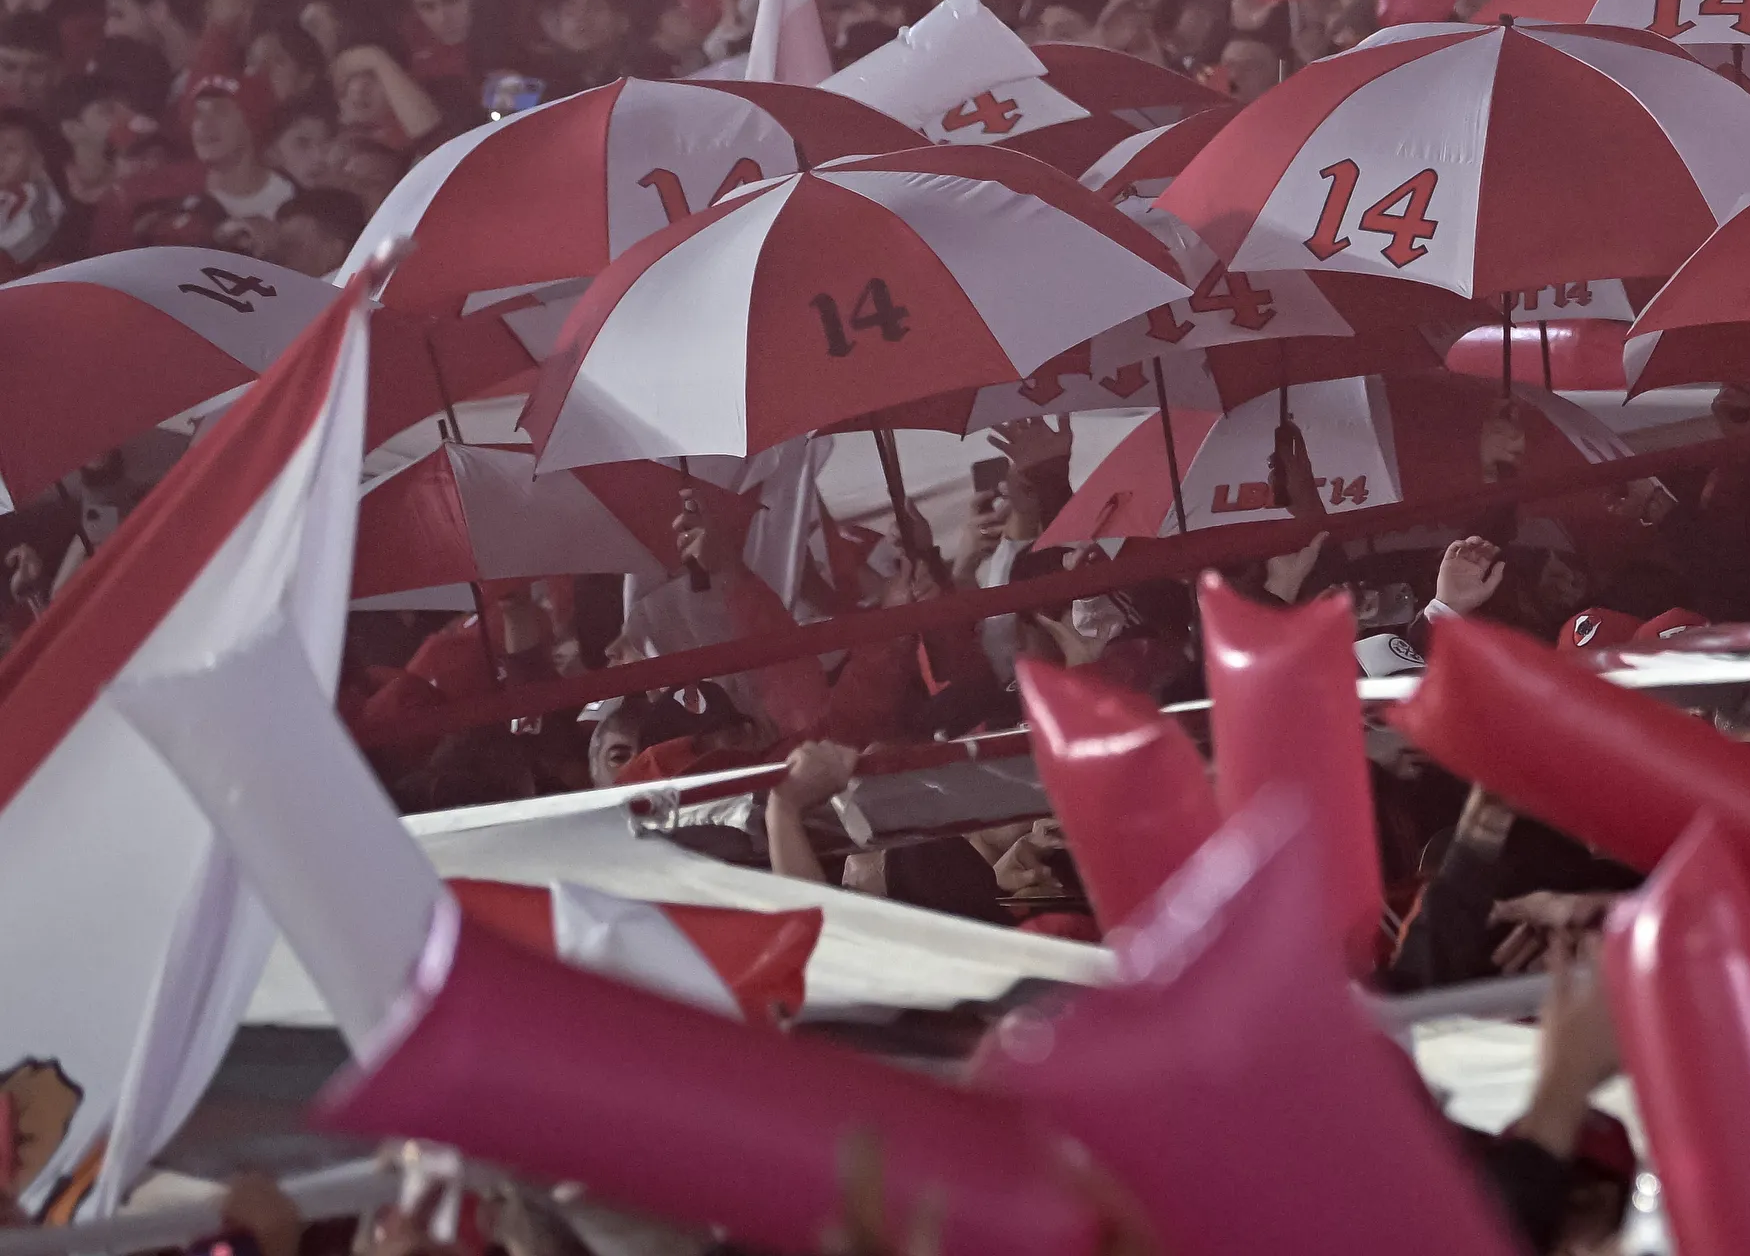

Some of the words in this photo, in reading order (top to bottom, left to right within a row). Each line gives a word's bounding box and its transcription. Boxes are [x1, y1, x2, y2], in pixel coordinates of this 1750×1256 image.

[1304, 158, 1440, 269] 14
[177, 267, 277, 313] 14
[808, 277, 911, 358] 14
[1330, 474, 1370, 506] 14
